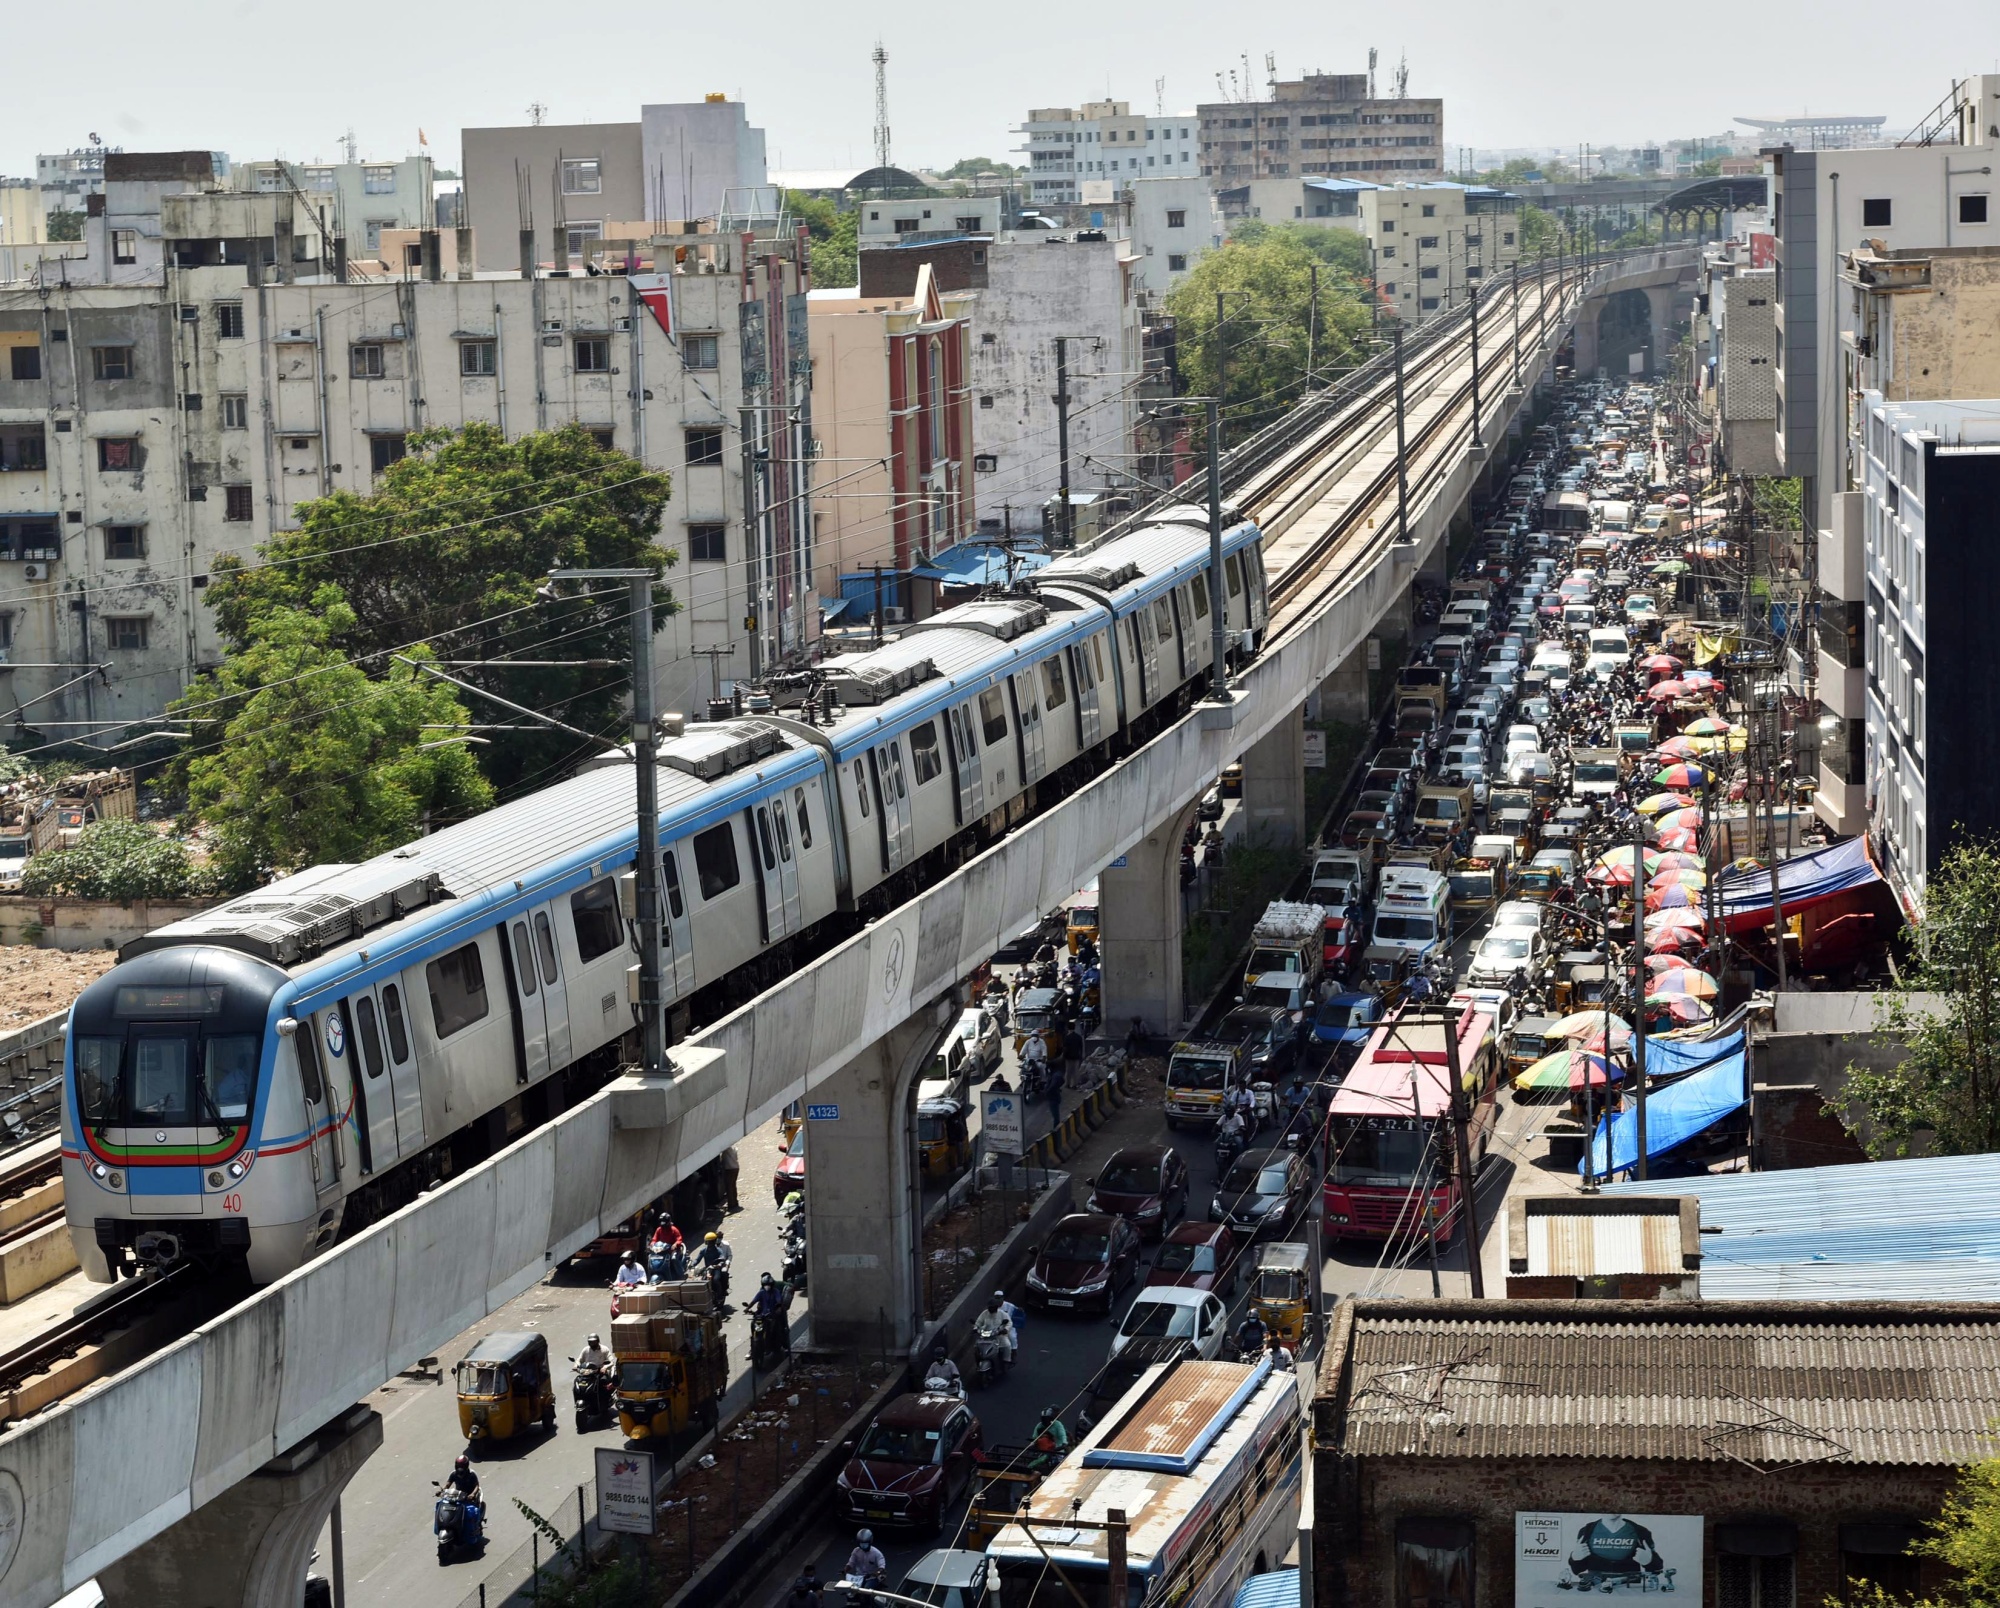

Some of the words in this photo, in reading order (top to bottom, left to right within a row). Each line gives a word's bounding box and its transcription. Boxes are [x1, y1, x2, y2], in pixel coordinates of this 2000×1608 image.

[223, 1194, 241, 1212] 40
[605, 1492, 621, 1502] 9885
[624, 1494, 636, 1503] 025
[637, 1495, 649, 1505] 144
